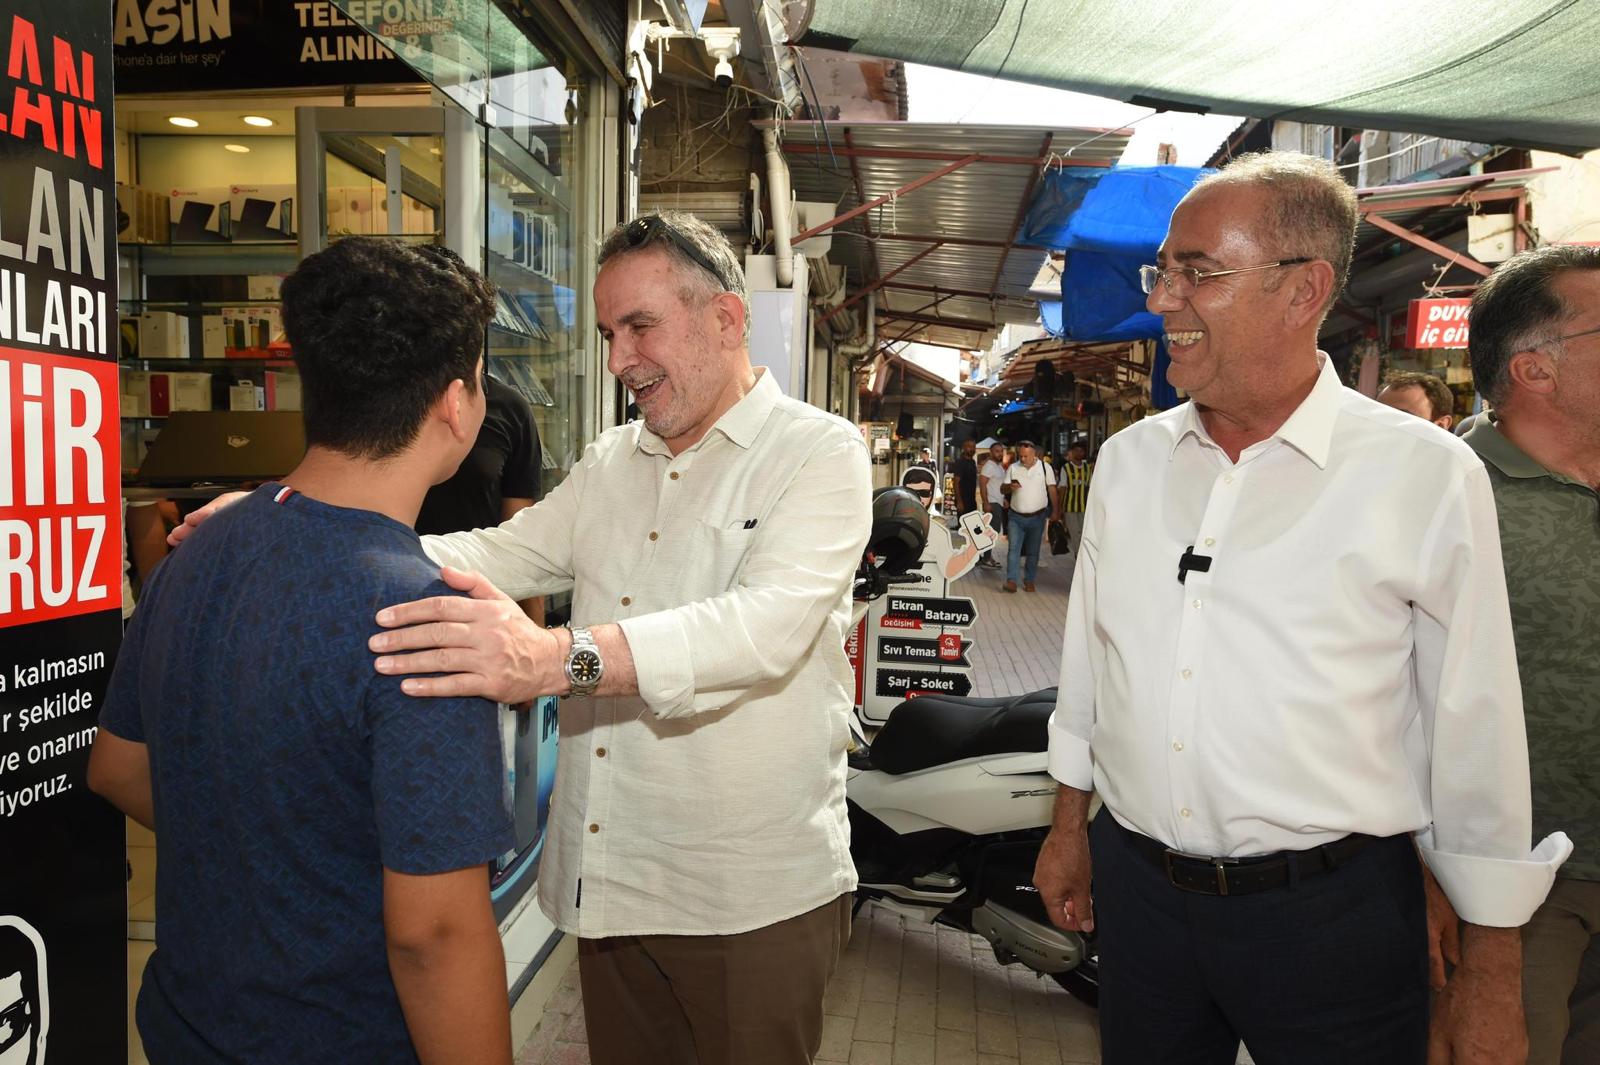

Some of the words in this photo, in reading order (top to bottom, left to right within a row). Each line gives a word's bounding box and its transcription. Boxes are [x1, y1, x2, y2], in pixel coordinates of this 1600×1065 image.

[156, 52, 177, 65] dair
[180, 50, 198, 64] her
[300, 36, 398, 62] ALINIR
[404, 35, 422, 59] &
[0, 15, 103, 169] AN
[1420, 323, 1440, 348] İÇ
[891, 600, 924, 612] Ekran
[925, 609, 969, 623] Batarya
[904, 645, 937, 658] Temas
[14, 651, 105, 690] kalmasın
[887, 675, 912, 689] Şarj
[920, 677, 954, 691] Soket
[19, 688, 93, 732] şekilde
[27, 725, 99, 765] onarım
[1010, 787, 1057, 799] PC
